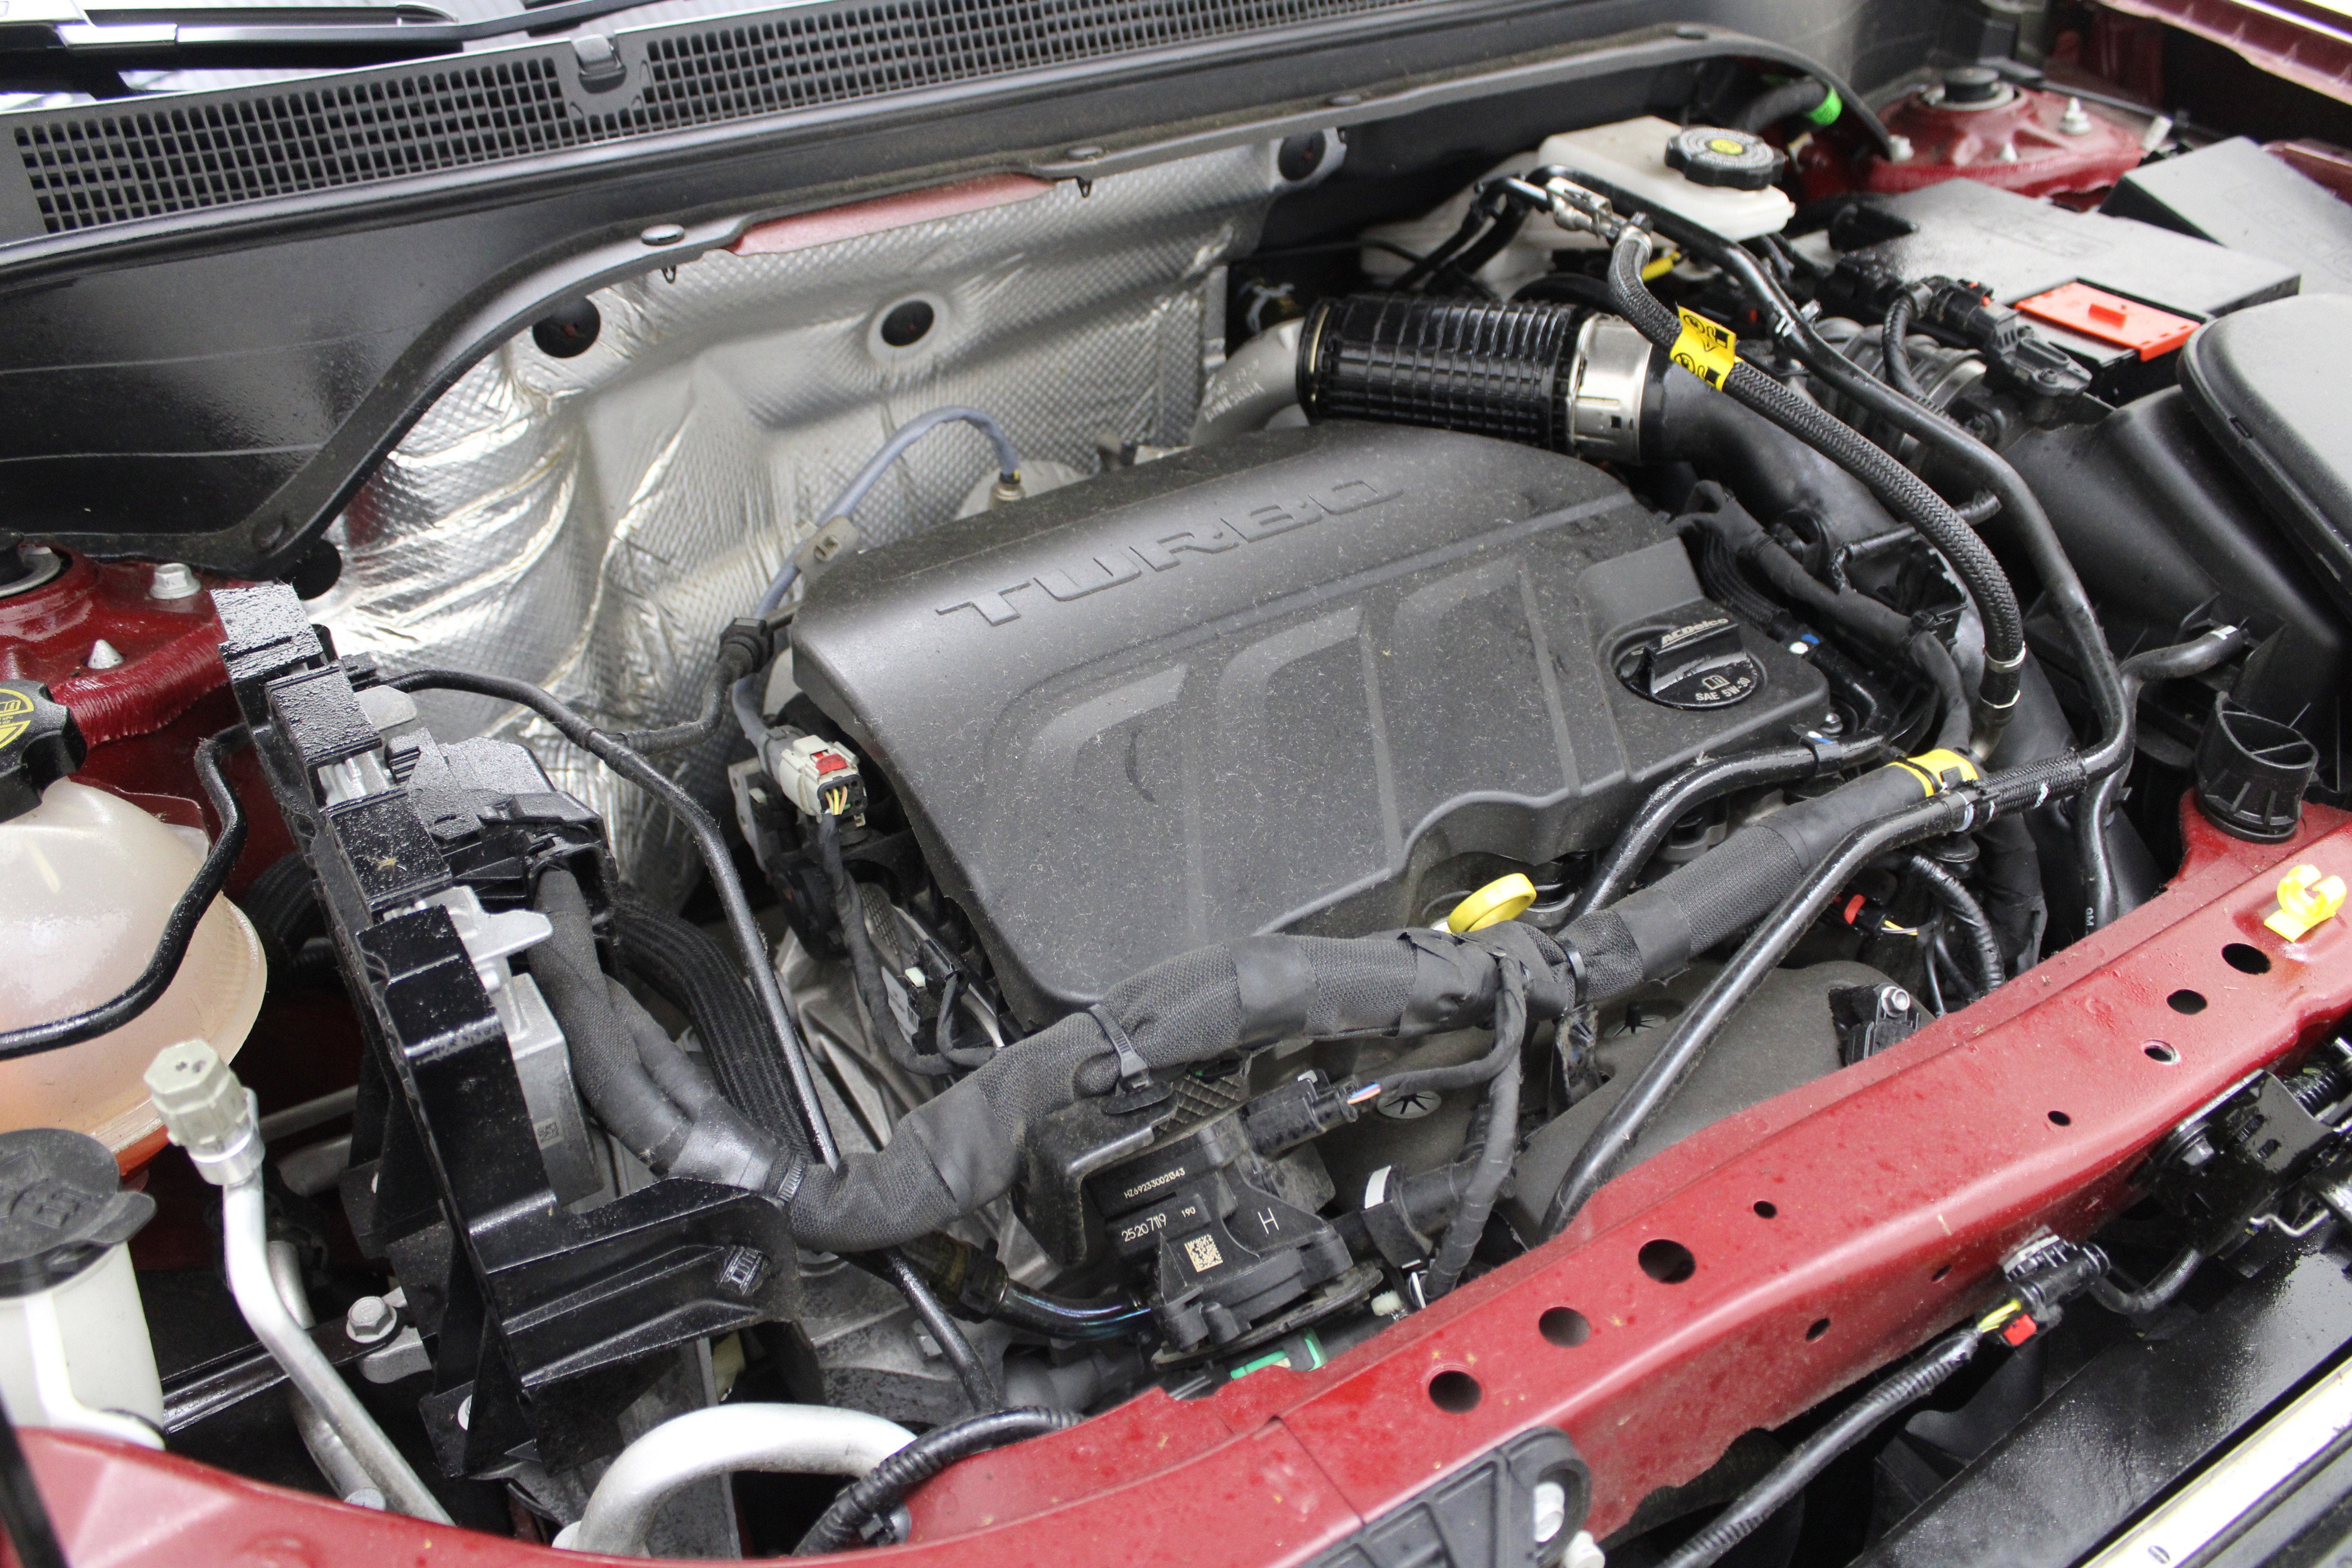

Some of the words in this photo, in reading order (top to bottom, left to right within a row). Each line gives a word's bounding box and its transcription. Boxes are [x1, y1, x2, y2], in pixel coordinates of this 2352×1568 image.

[935, 479, 1404, 626] TURBO
[1662, 618, 1729, 647] ACDelco
[1695, 692, 1720, 701] SAE
[1721, 677, 1751, 697] 5W-30
[1181, 1206, 1196, 1218] 190
